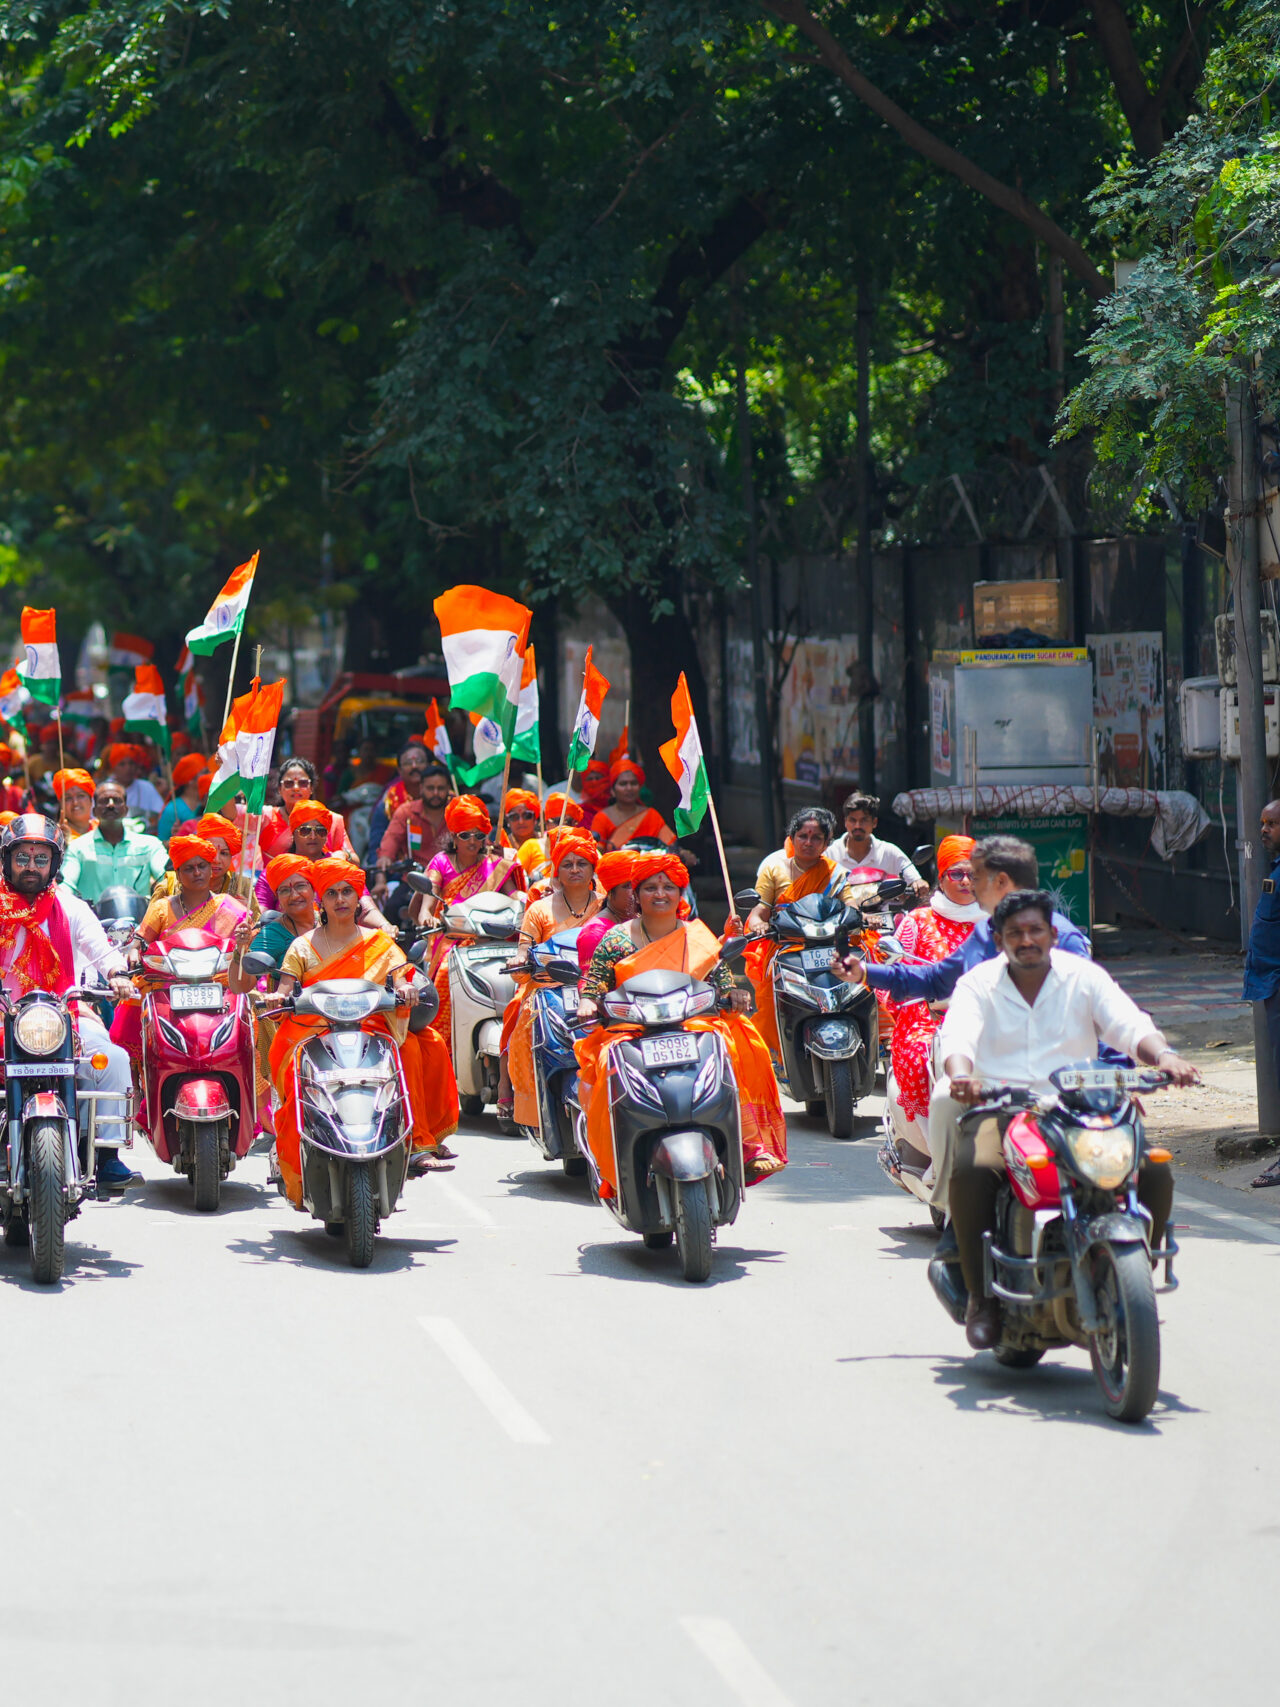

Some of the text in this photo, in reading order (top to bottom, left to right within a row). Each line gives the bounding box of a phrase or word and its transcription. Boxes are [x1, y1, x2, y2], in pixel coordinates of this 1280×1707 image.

[1037, 652, 1056, 660] SUGAR
[1030, 820, 1050, 829] SUGAR
[1051, 819, 1066, 828] CANE
[810, 951, 821, 959] TG
[651, 1036, 689, 1051] TS09G
[653, 1047, 692, 1062] D5164
[24, 1067, 34, 1075] 09
